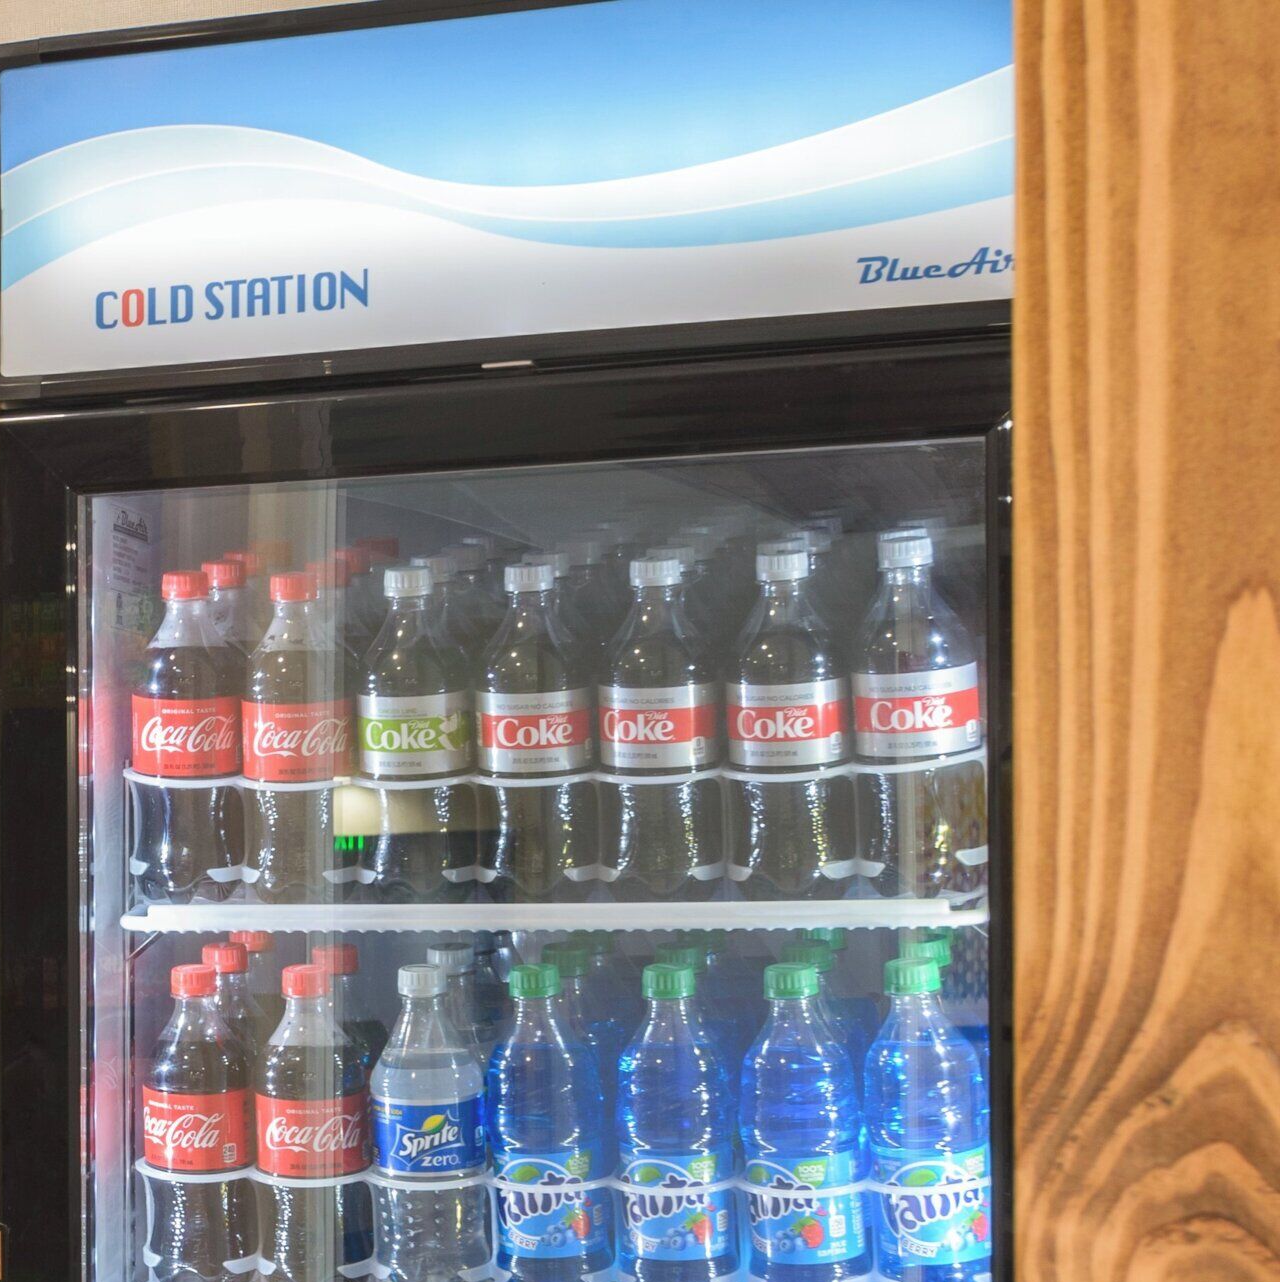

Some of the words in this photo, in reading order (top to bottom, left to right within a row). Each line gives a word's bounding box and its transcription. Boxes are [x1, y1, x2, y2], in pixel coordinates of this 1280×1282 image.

[95, 283, 192, 330] COLD
[205, 268, 369, 320] STATION
[604, 711, 674, 741] Coke
[646, 711, 668, 720] Diet
[737, 709, 814, 738] Coke
[784, 707, 808, 718] Diet
[870, 700, 952, 730] Coke
[141, 716, 236, 753] Coca-Cola
[253, 718, 350, 757] Coca-Cola
[366, 720, 437, 750] Coke
[497, 718, 572, 746] Coke
[143, 1108, 225, 1149] Coca-Cola
[266, 1113, 362, 1153] Coca-Cola
[402, 1126, 458, 1158] Sprite
[422, 1153, 458, 1167] zero
[509, 1232, 537, 1249] BERRY
[903, 1239, 937, 1256] BERRY
